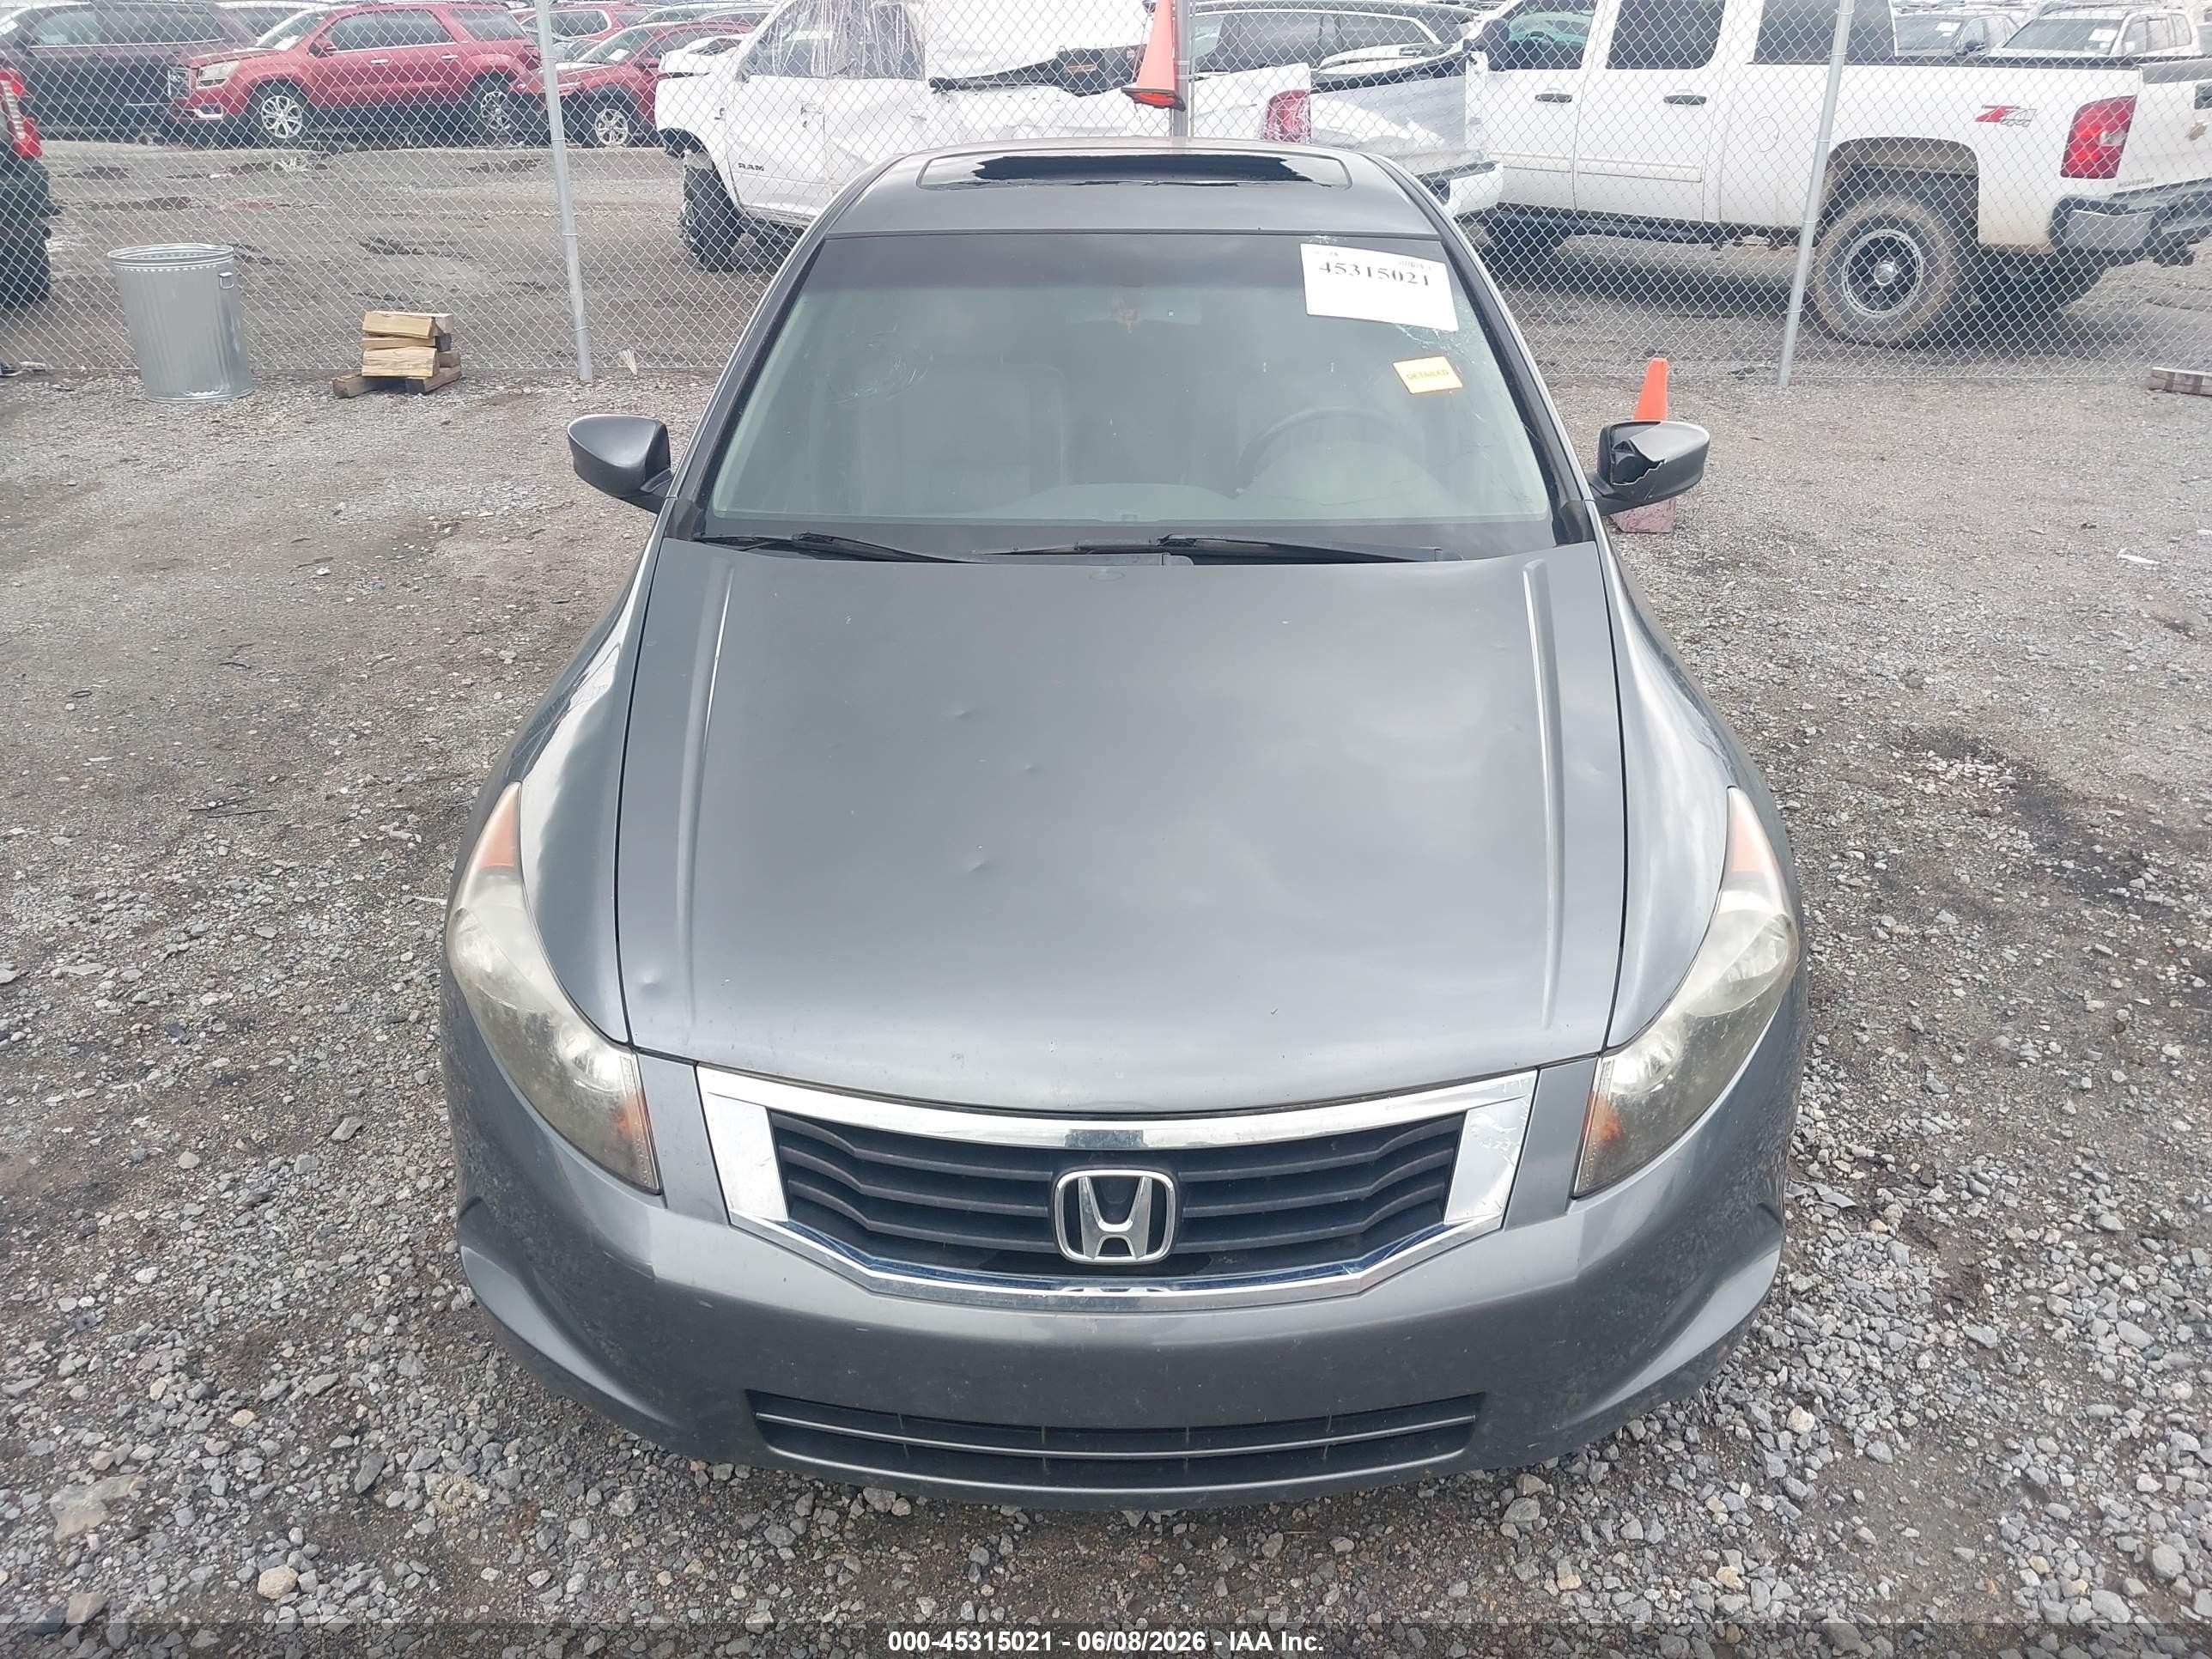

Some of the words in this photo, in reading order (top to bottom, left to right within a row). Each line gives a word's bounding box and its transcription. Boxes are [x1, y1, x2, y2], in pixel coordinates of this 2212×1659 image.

[737, 162, 765, 172] RAM
[1318, 261, 1430, 286] 45315021
[1406, 369, 1449, 380] DETAILED
